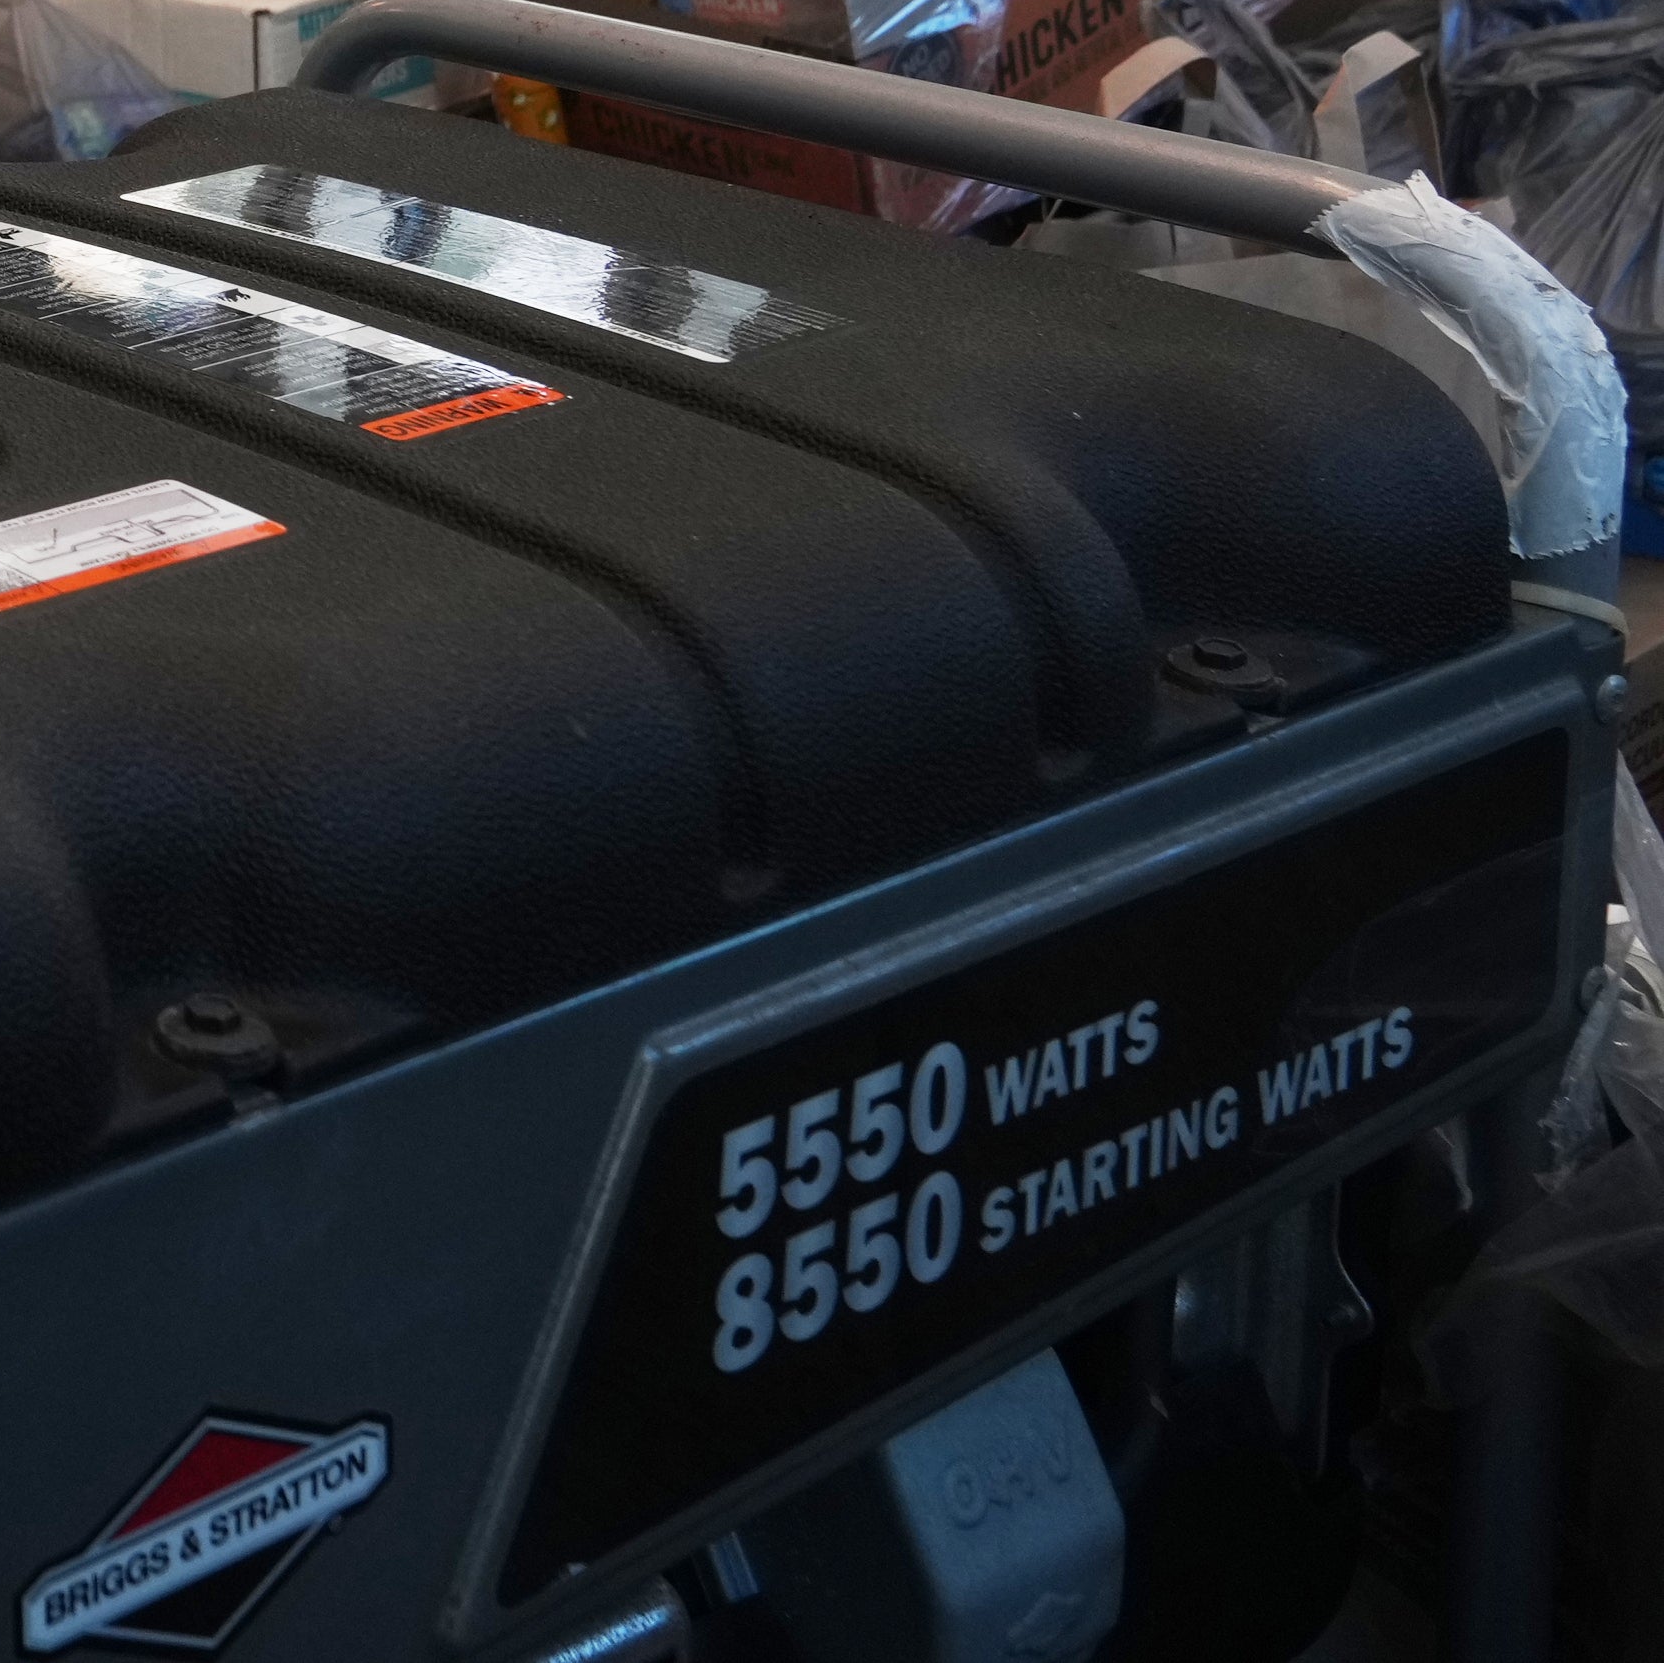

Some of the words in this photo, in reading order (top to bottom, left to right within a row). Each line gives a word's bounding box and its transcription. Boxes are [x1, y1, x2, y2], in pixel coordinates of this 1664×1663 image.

[378, 398, 513, 436] WARNING
[711, 1170, 963, 1375] 8550
[980, 1085, 1240, 1254] STARTING
[1258, 1005, 1414, 1128] WATTS
[714, 1041, 967, 1239] 5550
[985, 1000, 1161, 1128] WATTS
[43, 1545, 171, 1628] BRIGGS
[178, 1522, 204, 1563] &
[208, 1448, 370, 1552] STRATTON
